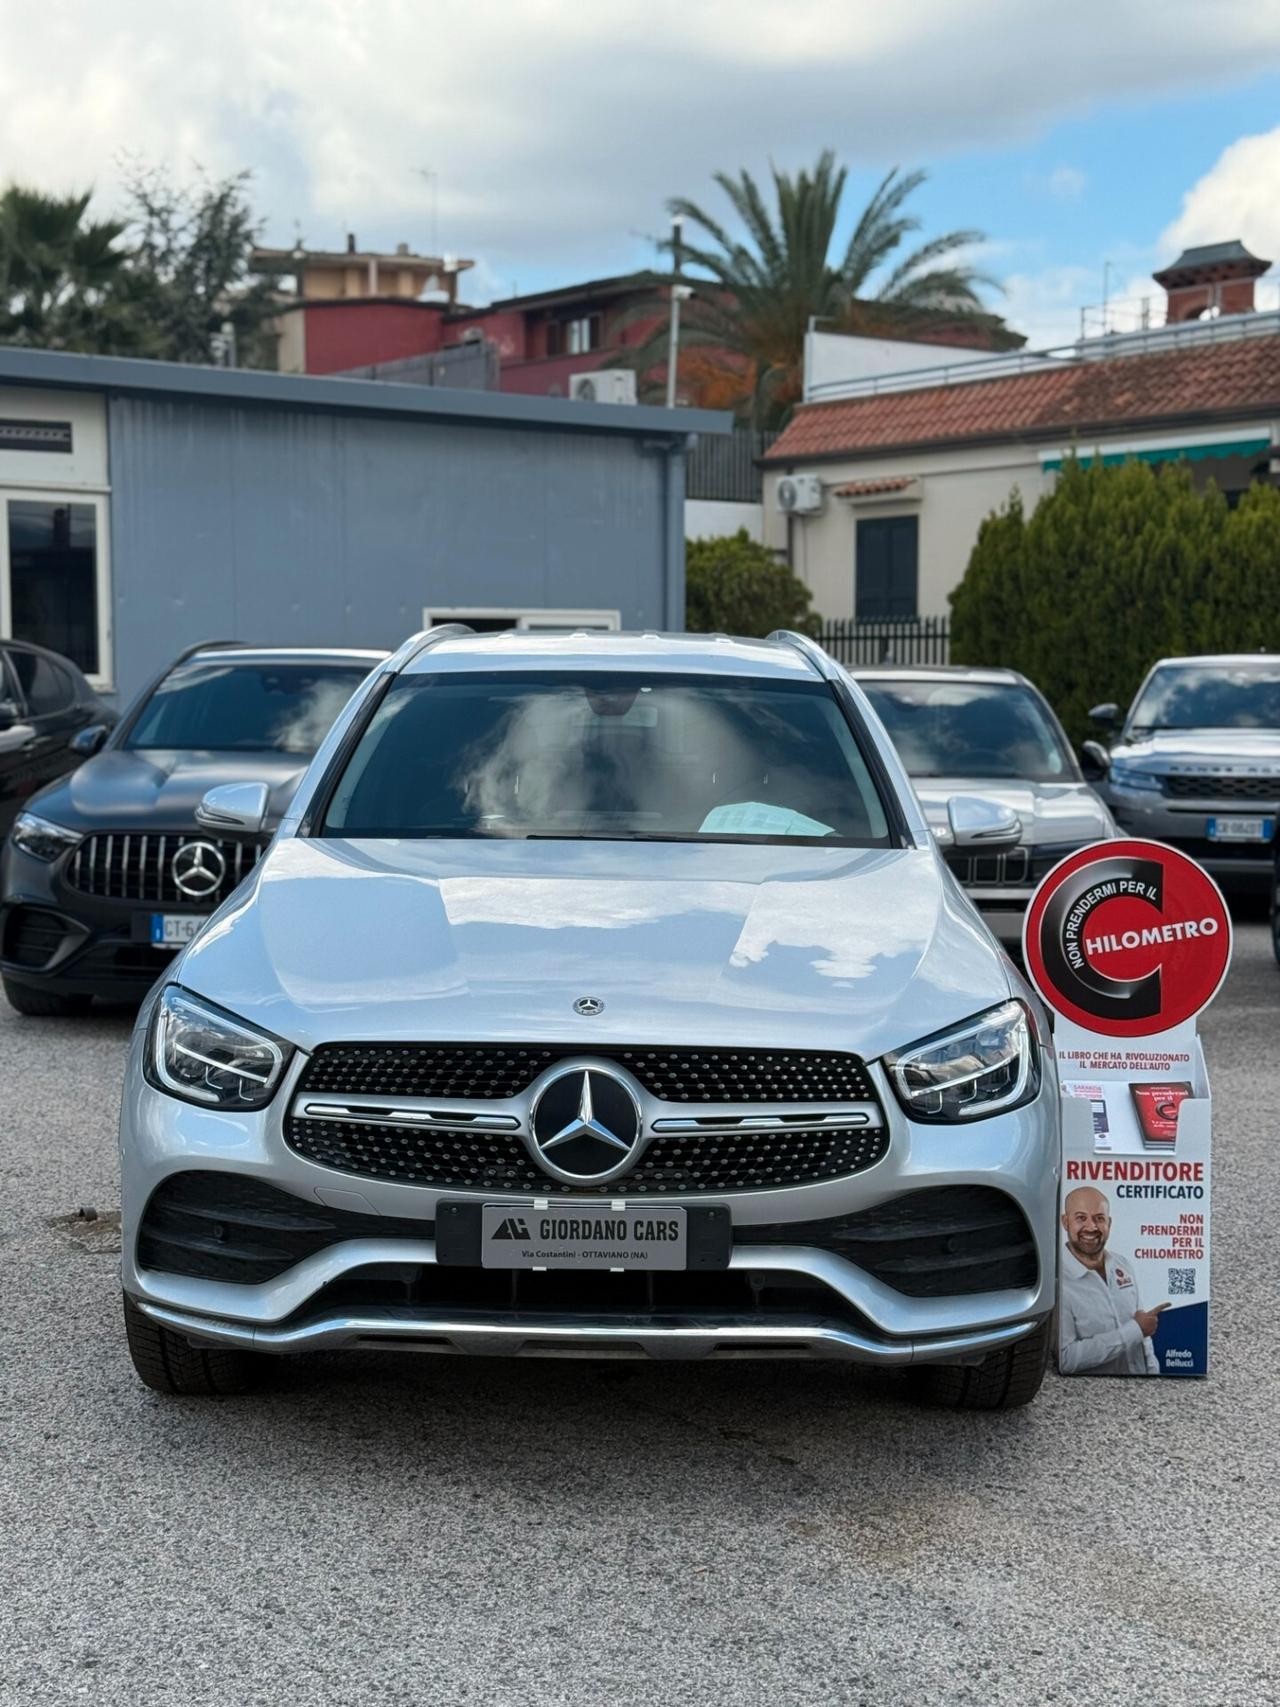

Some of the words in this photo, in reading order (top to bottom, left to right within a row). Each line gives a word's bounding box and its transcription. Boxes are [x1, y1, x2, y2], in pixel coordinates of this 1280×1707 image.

[1119, 880, 1145, 894] PER
[1146, 885, 1158, 901] IL
[1066, 882, 1118, 940] PRENDERMI
[1066, 942, 1084, 969] NON
[1059, 1051, 1066, 1060] IL
[1067, 1051, 1092, 1060] LIBRO
[1092, 1051, 1109, 1061] CHE
[1109, 1052, 1122, 1061] HA
[1125, 1053, 1190, 1063] RIVOLUZIONATO
[1079, 1060, 1087, 1069] IL
[1090, 1061, 1128, 1070] MERCATO
[1129, 1062, 1171, 1071] DELL'AUTO
[1066, 1160, 1204, 1182] RIVENDITORE
[1116, 1184, 1204, 1200] CERTIFICATO
[1179, 1213, 1204, 1225] NON
[540, 1218, 627, 1241] GIORDANO
[633, 1219, 679, 1242] CARS
[1140, 1225, 1204, 1236] PRENDERMI
[1172, 1237, 1192, 1248] PER
[1195, 1237, 1204, 1248] IL
[521, 1250, 534, 1258] Via
[535, 1250, 576, 1259] Costantini
[582, 1251, 629, 1259] OTTAVIANO
[630, 1251, 648, 1260] (NA)
[1134, 1248, 1204, 1260] CHILOMETRO
[1165, 1349, 1192, 1359] Alfredo
[1165, 1359, 1194, 1368] Bellucci
